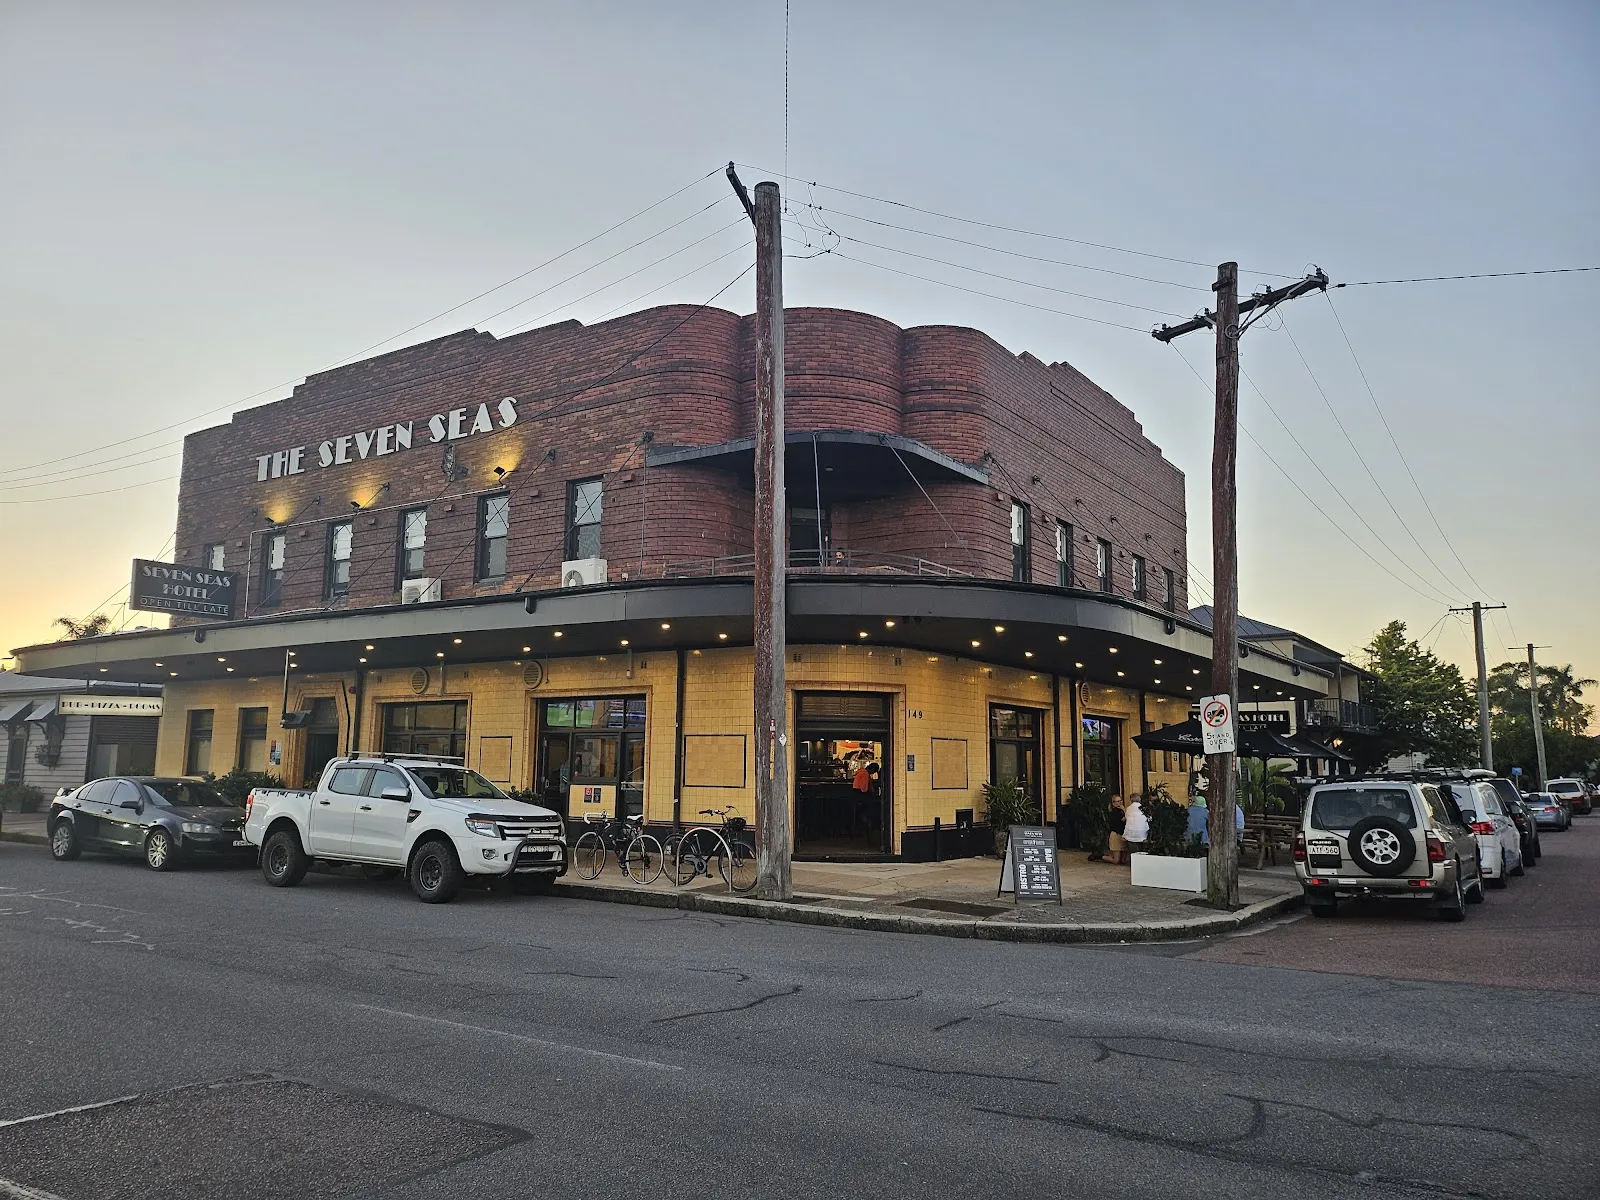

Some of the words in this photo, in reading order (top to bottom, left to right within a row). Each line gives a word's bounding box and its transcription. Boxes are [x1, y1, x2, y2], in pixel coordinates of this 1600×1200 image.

[256, 446, 306, 482] THE
[318, 420, 414, 468] SEVEN
[428, 396, 518, 443] SEAS
[143, 565, 192, 581] SEVEN
[195, 572, 231, 588] SEAS
[162, 583, 211, 600] HOTEL
[140, 598, 171, 608] OPEN
[177, 601, 200, 611] TILL
[203, 605, 229, 614] LATE
[908, 709, 923, 719] 149
[1252, 713, 1287, 722] HOTEL
[1209, 738, 1228, 746] OVER
[1044, 848, 1053, 863] BAR
[1019, 864, 1028, 889] BISTRO
